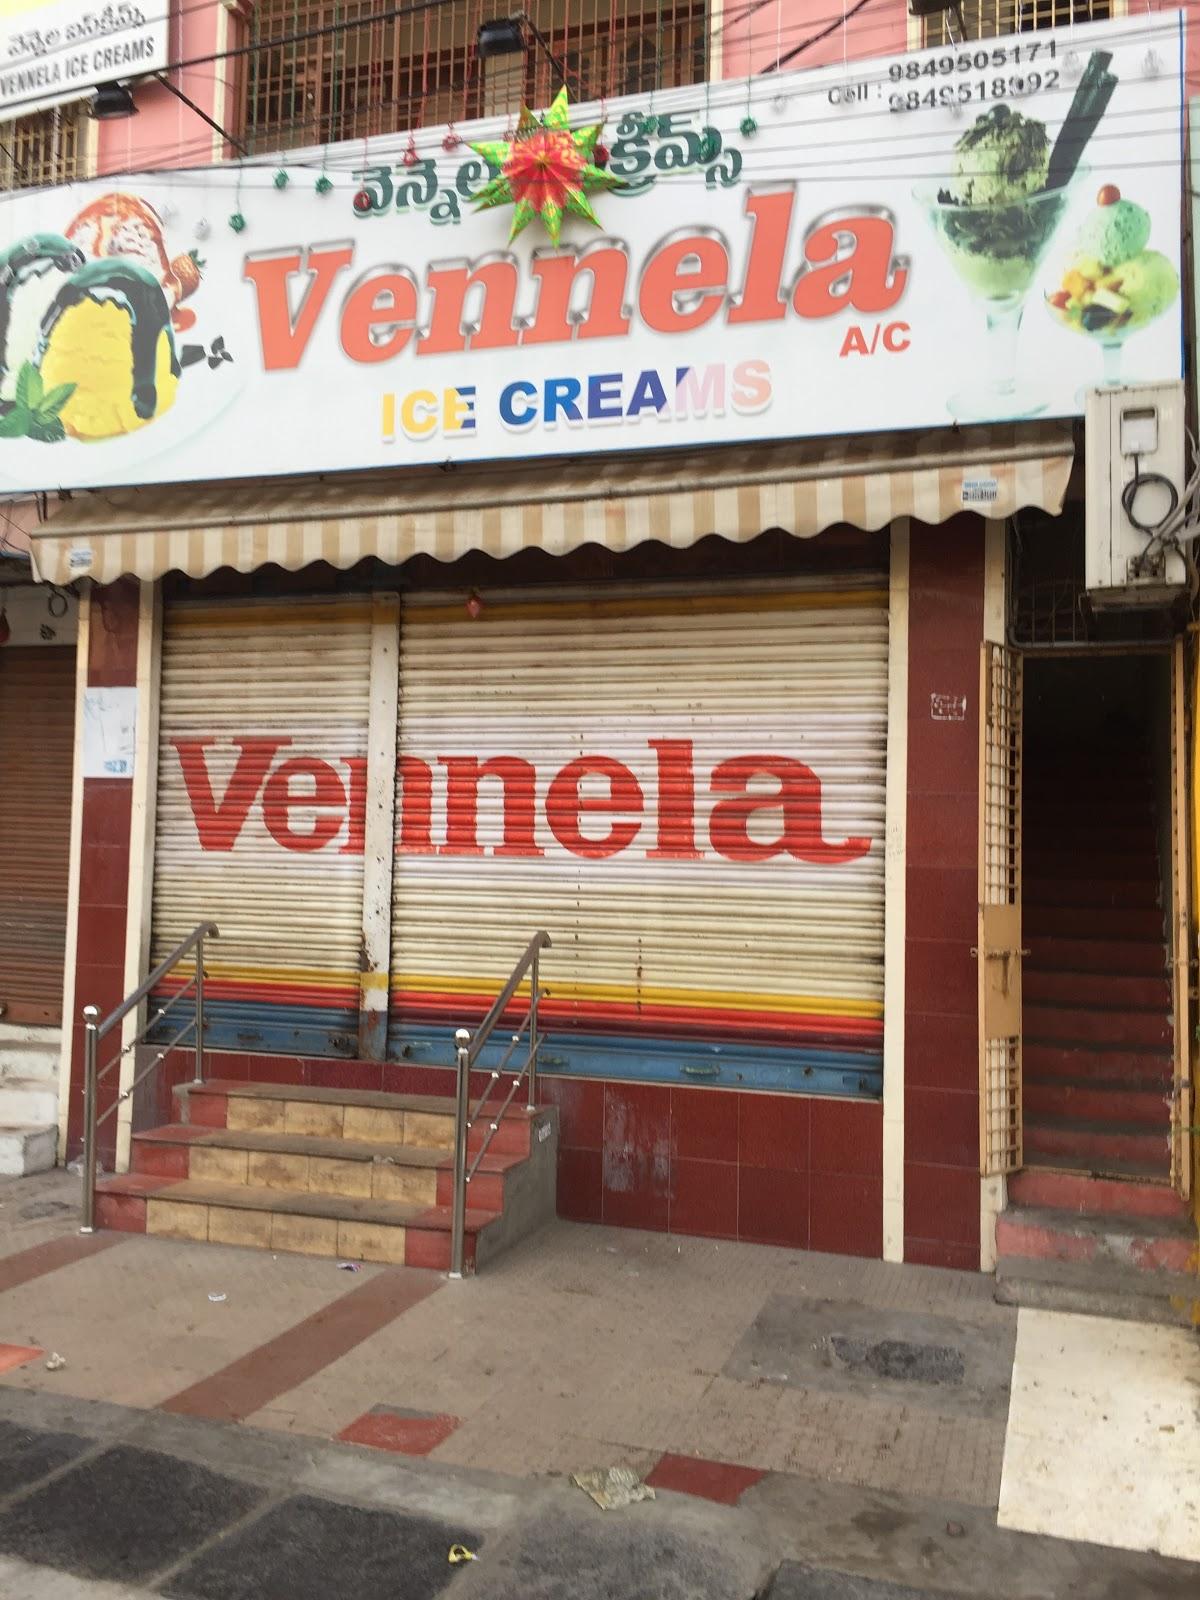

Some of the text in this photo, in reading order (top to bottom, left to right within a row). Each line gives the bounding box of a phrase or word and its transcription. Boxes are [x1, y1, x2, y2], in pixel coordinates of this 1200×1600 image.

[0, 36, 154, 95] VENNELA ICE CREAMS
[888, 39, 1057, 83] 9849505171
[243, 181, 911, 373] Vennela
[839, 321, 911, 357] A/C
[380, 359, 772, 440] ICE CREAMS
[169, 736, 873, 864] Vennela
